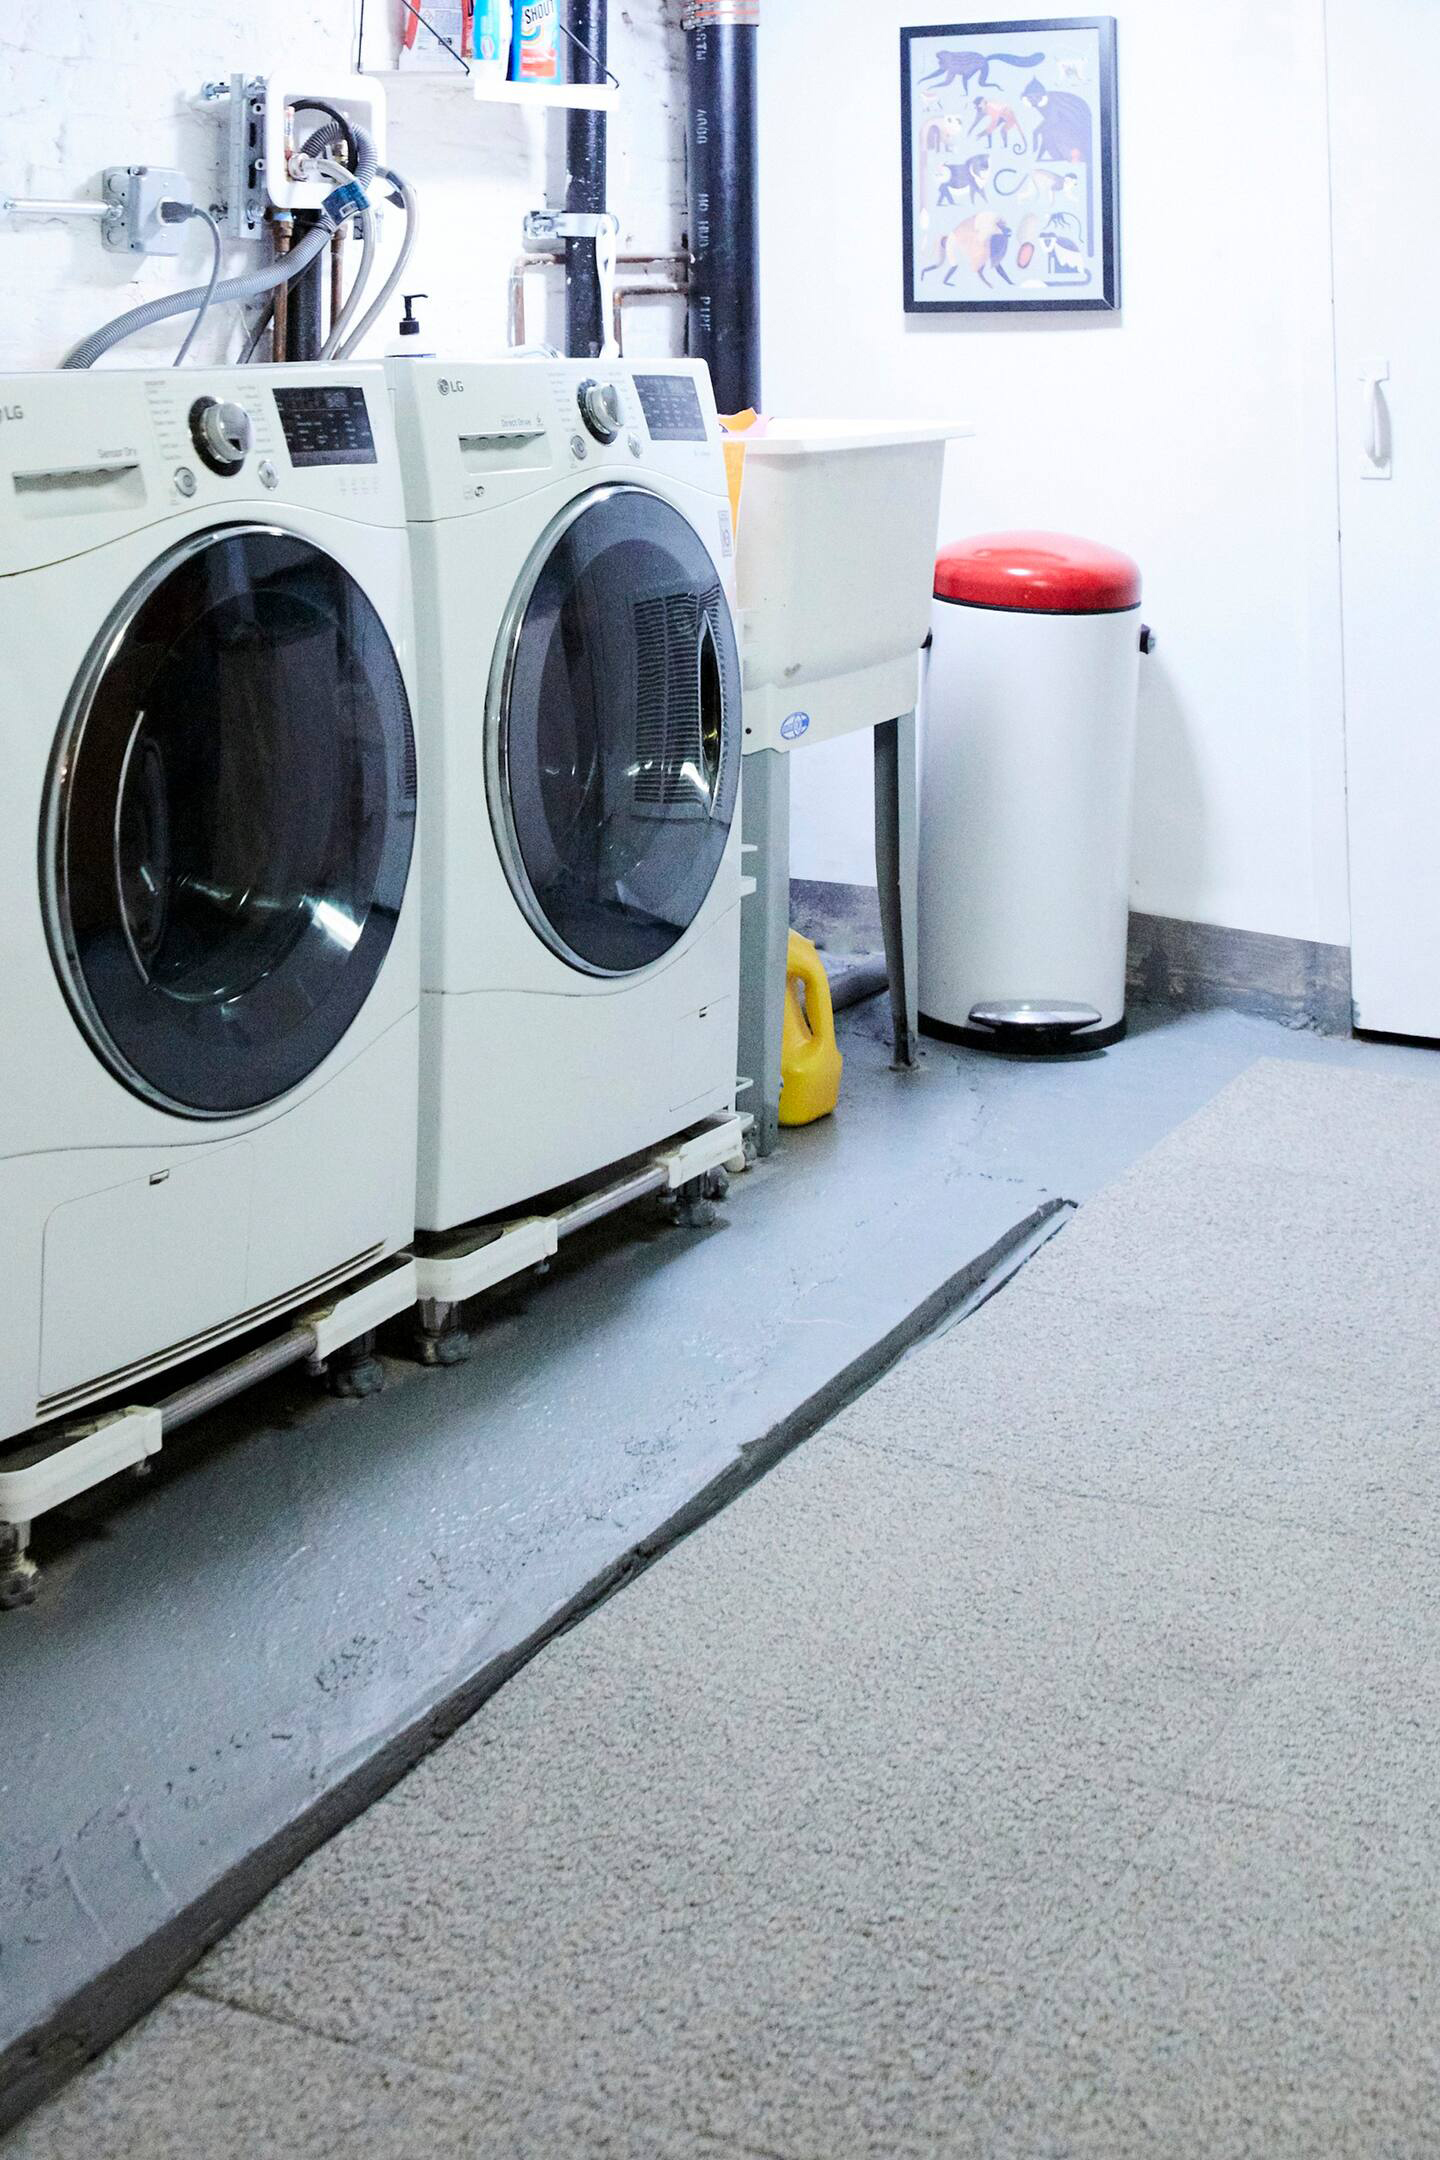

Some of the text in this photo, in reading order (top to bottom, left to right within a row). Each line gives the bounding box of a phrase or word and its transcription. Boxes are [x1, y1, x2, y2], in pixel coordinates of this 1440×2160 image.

[524, 0, 554, 24] SHOUT
[450, 380, 464, 393] LG
[4, 404, 24, 421] LG
